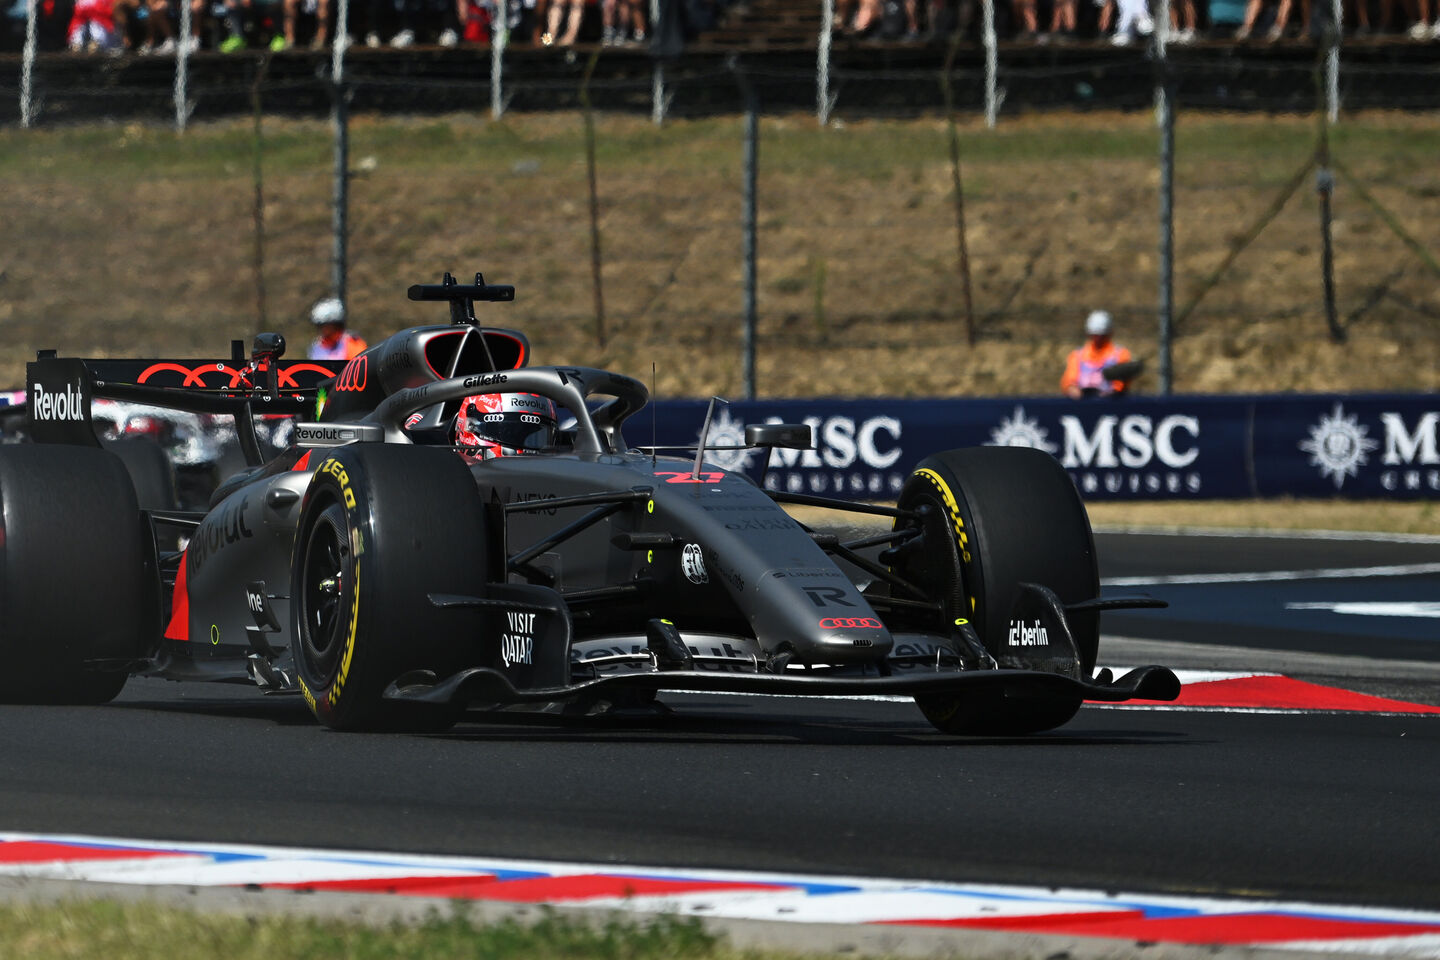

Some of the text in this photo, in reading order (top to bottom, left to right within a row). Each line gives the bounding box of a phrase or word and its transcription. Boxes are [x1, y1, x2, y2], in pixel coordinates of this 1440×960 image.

[463, 373, 508, 389] Gillette
[33, 377, 85, 422] Revolut
[295, 427, 338, 440] Revolut
[764, 415, 903, 469] MSC
[1060, 414, 1200, 468] MSC
[321, 457, 357, 510] ZERO
[1068, 471, 1201, 493] RUISES
[801, 586, 857, 607] R
[507, 611, 536, 635] VISIT
[1021, 619, 1049, 646] berlin
[501, 633, 534, 668] QATAR
